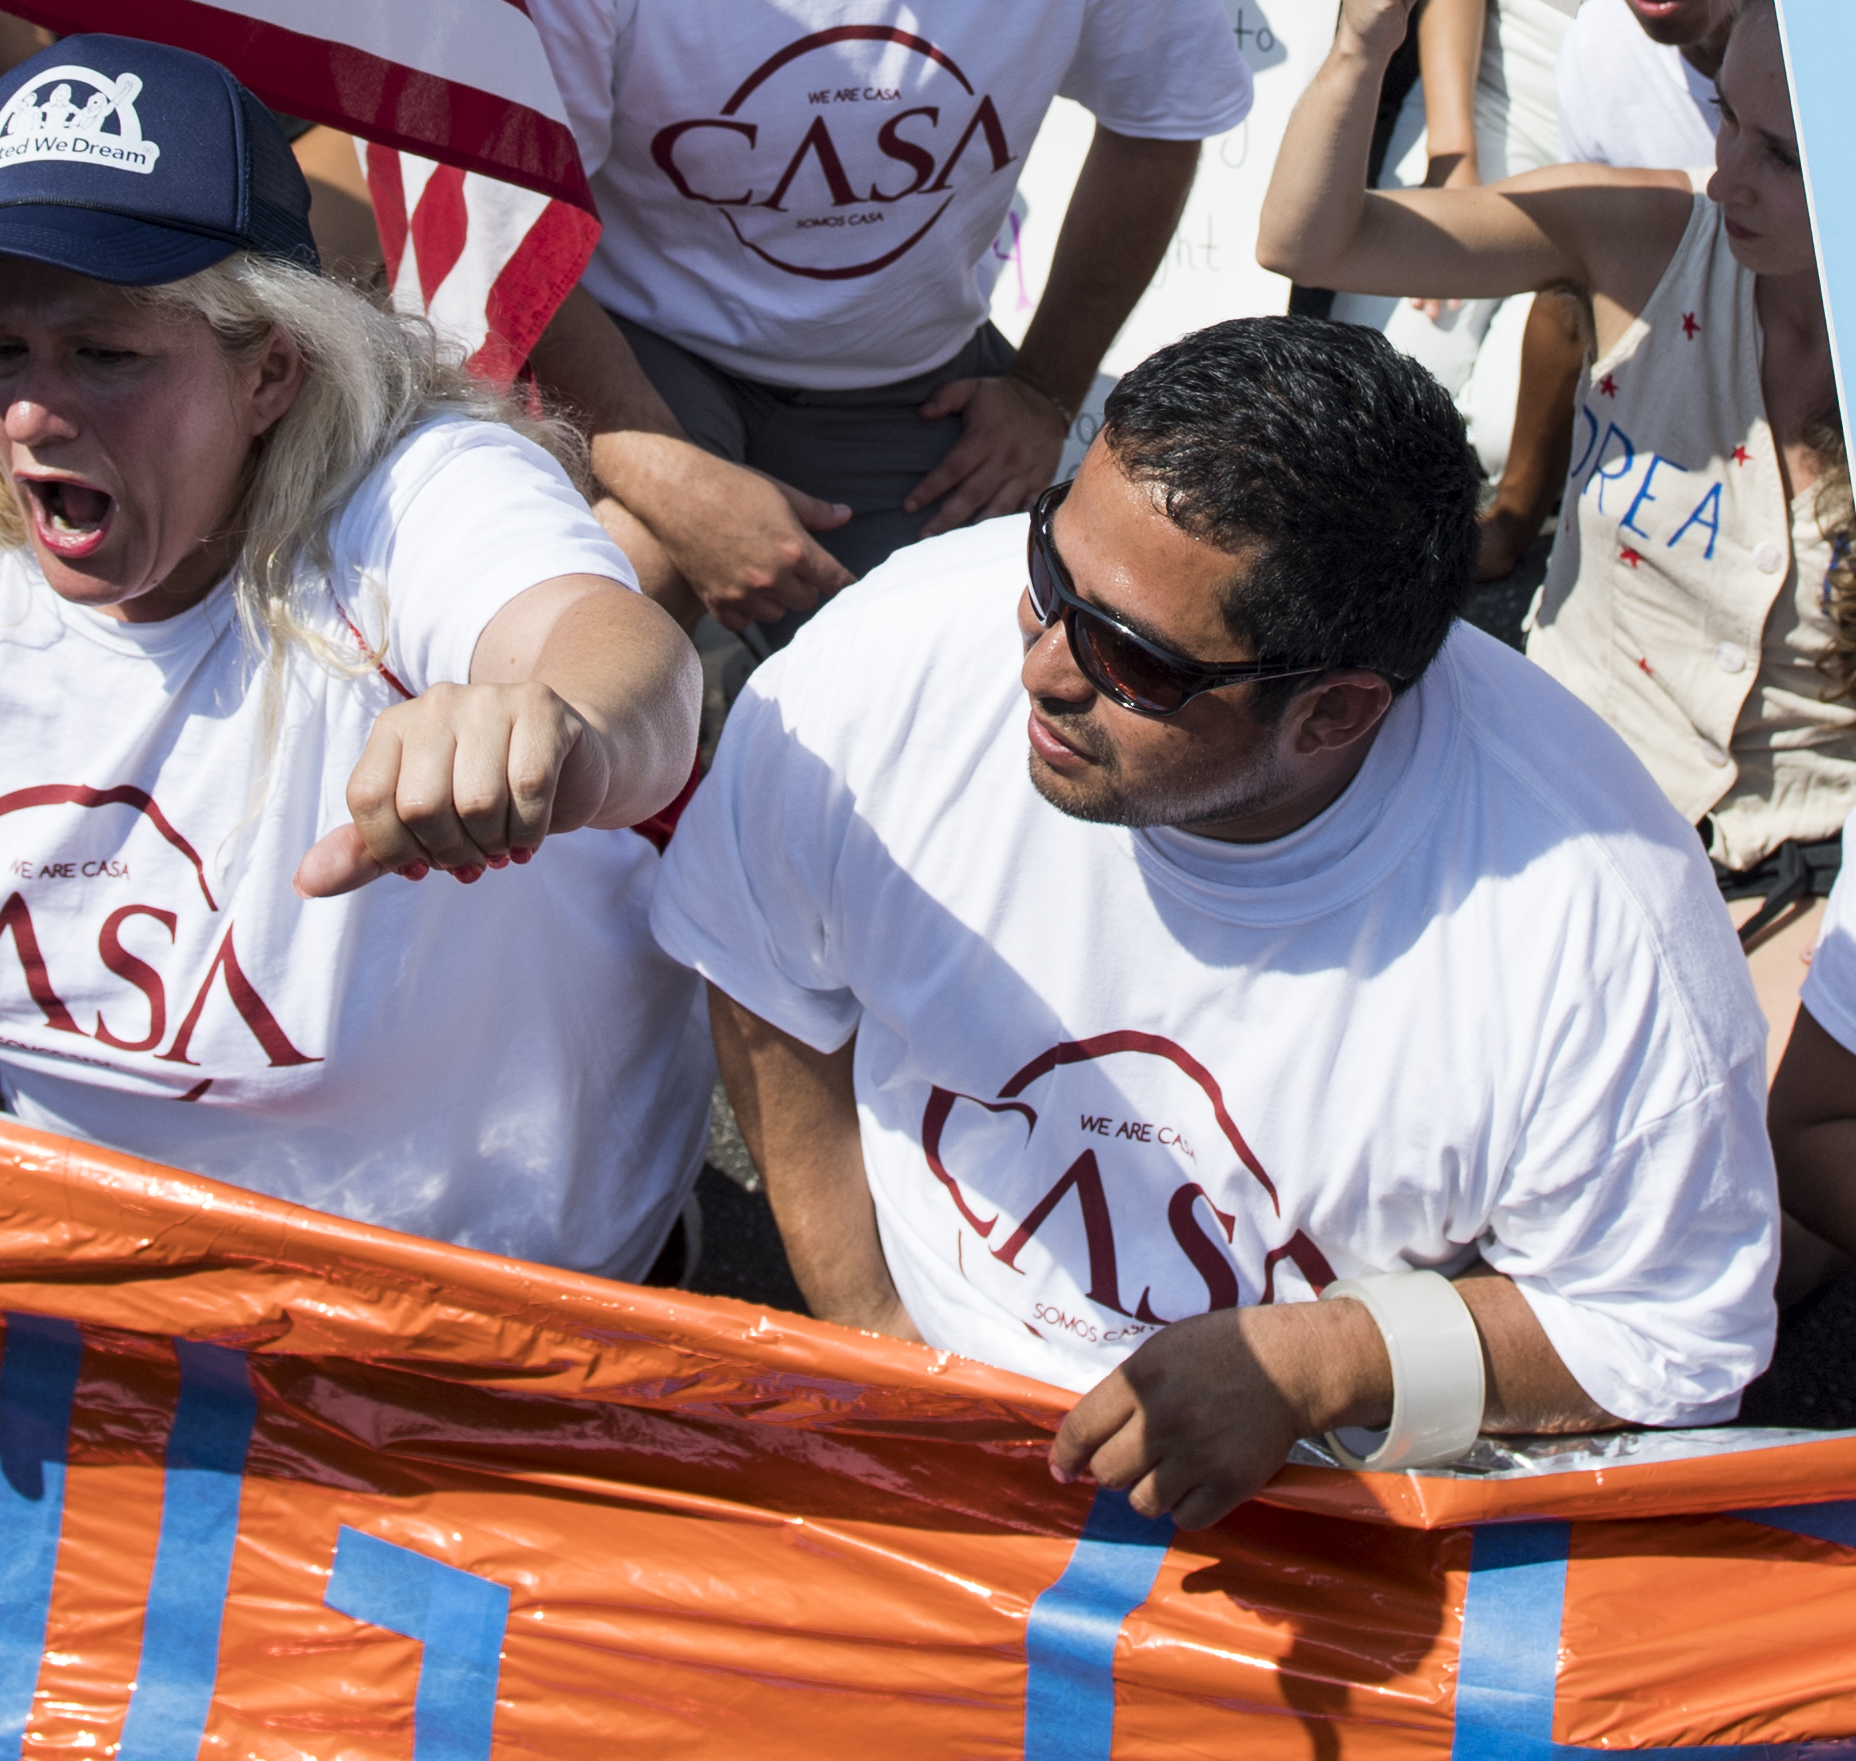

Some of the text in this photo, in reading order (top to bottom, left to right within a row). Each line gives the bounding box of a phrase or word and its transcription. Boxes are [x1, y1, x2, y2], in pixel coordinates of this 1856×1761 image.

[1233, 8, 1276, 53] to
[808, 87, 902, 105] WE ARE CASA
[34, 137, 68, 152] We
[72, 137, 147, 166] Dream
[650, 94, 1018, 213] CASA
[795, 211, 884, 229] SOMOS CASA
[39, 861, 77, 879] ARE
[81, 860, 131, 881] CASA
[1080, 1114, 1112, 1136] WE
[1115, 1122, 1153, 1142] ARE
[1033, 1303, 1097, 1342] SOMOS
